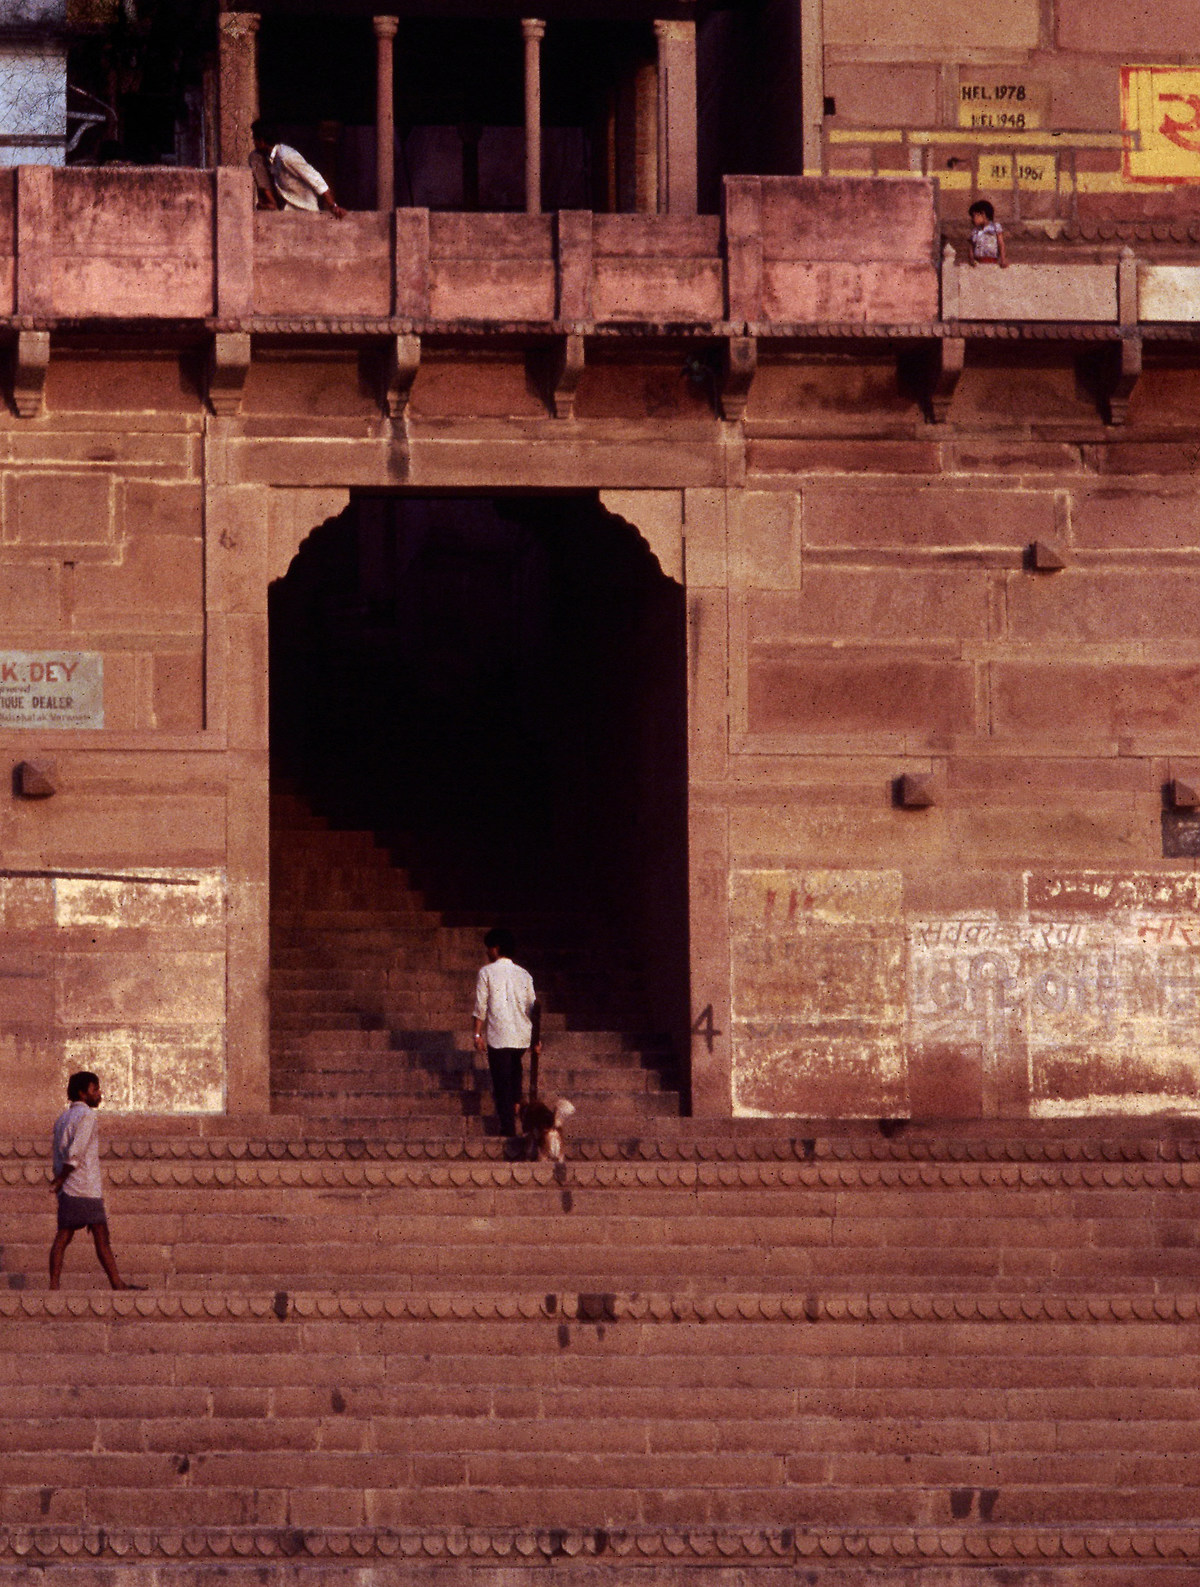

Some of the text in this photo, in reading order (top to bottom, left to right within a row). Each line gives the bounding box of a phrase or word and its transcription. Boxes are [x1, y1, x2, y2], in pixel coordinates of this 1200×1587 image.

[995, 85, 1026, 101] 1978
[995, 113, 1026, 128] 1948
[32, 696, 74, 709] DEALER
[691, 1003, 723, 1055] 4
